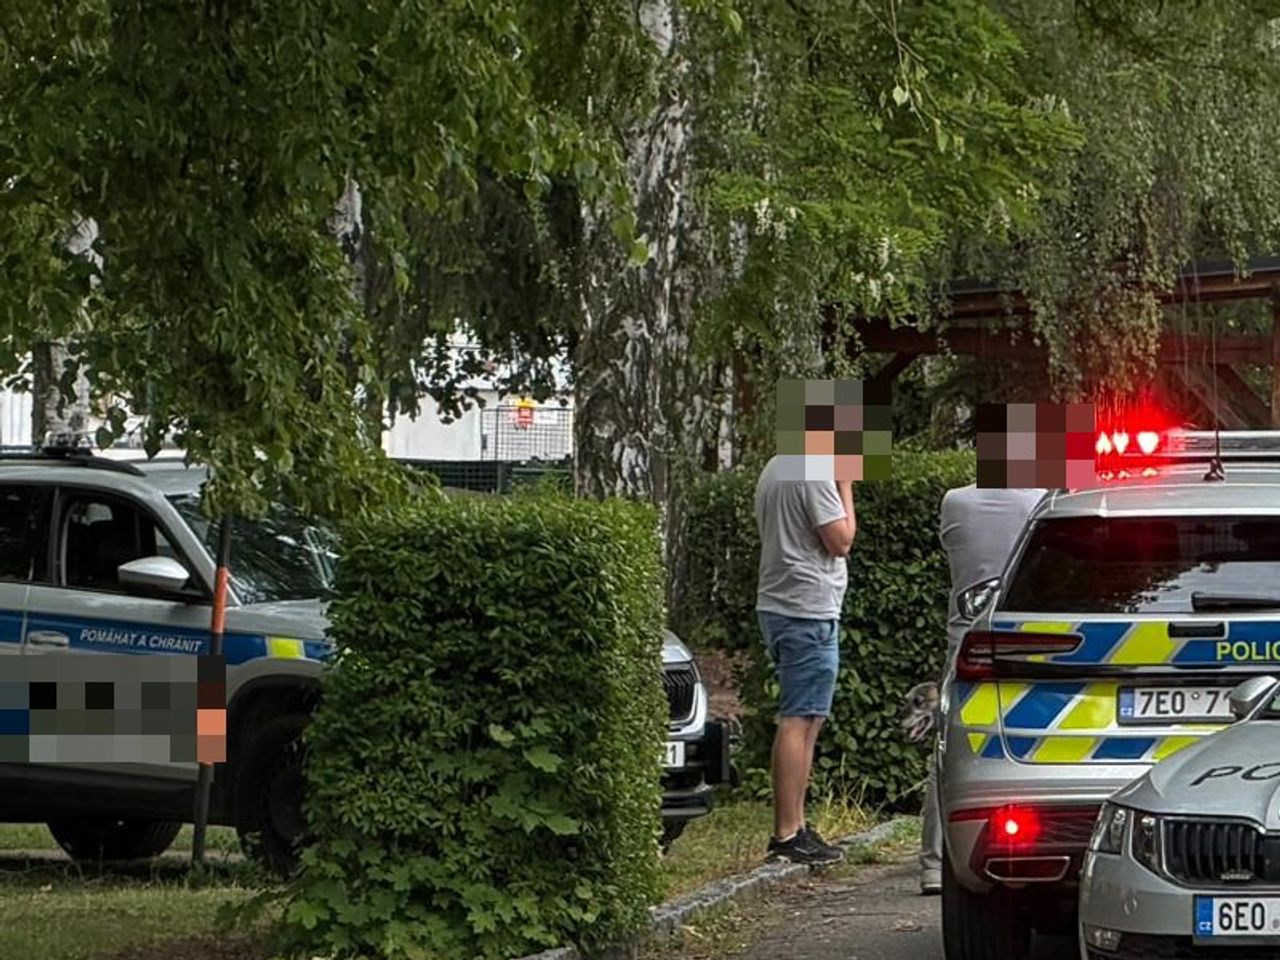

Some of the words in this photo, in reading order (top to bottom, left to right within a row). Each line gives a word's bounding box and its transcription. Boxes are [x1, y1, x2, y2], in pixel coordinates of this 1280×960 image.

[80, 628, 137, 646] POMÁHAT
[137, 635, 147, 647] A
[149, 634, 203, 652] CHRÁNIT
[1206, 691, 1232, 715] 7
[1219, 902, 1266, 931] 6E0
